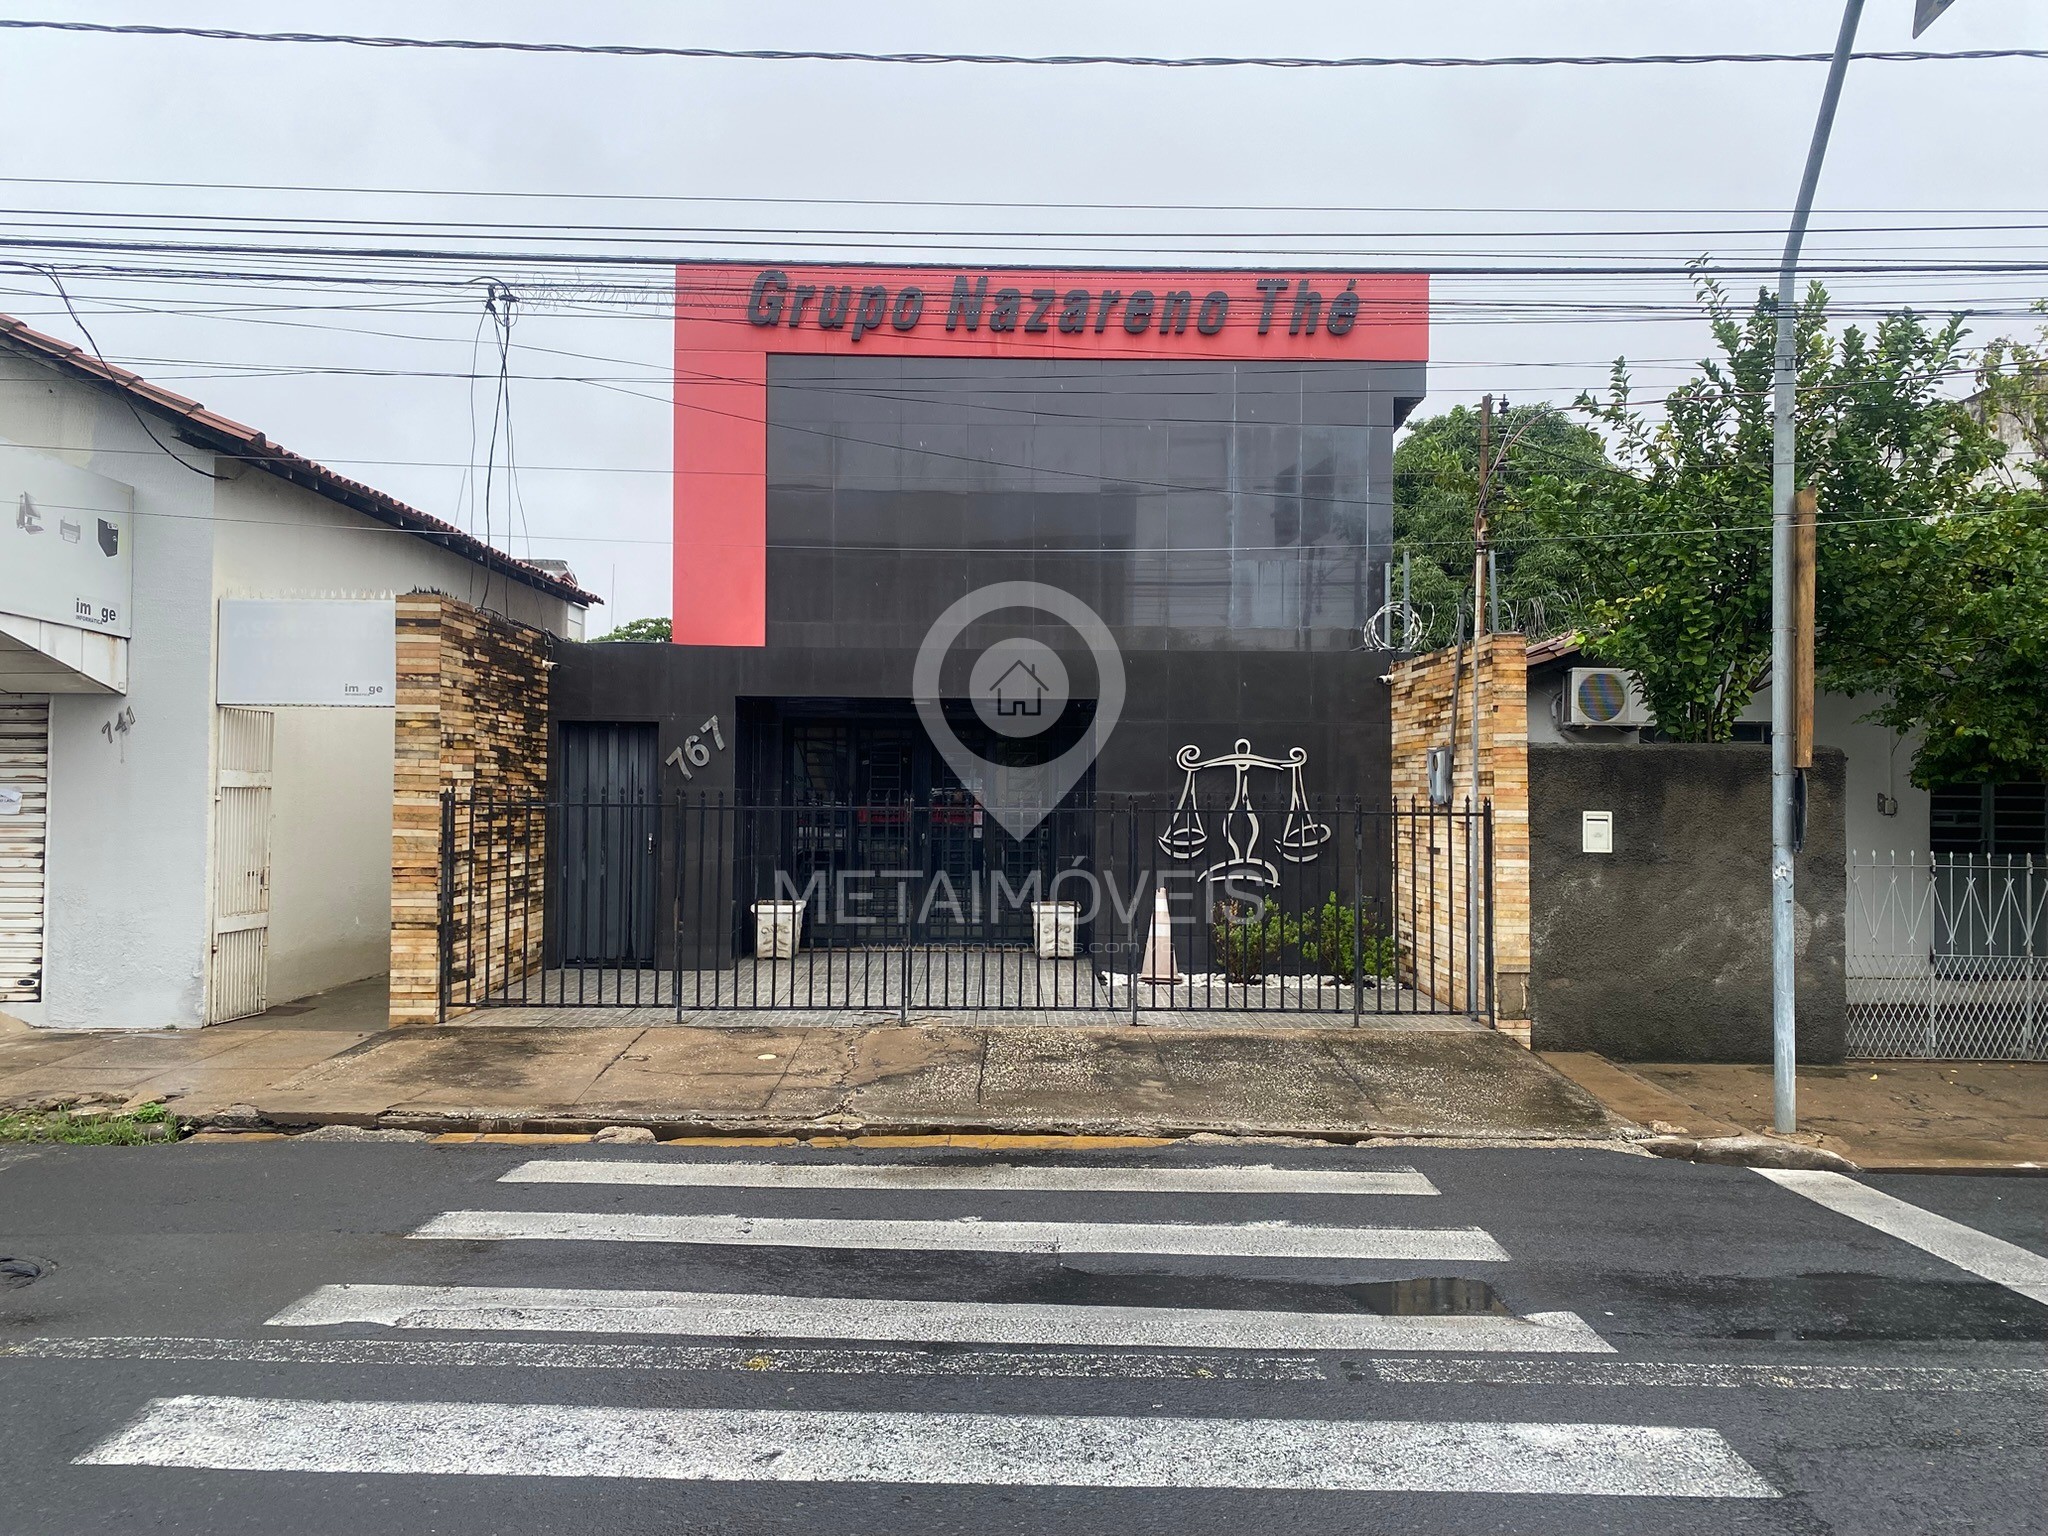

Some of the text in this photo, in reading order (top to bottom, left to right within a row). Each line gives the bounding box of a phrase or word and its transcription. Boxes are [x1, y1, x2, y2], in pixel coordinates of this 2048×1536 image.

[749, 269, 1361, 342] Grupo Nazareno Thé
[102, 705, 136, 744] 741
[665, 714, 725, 781] 767
